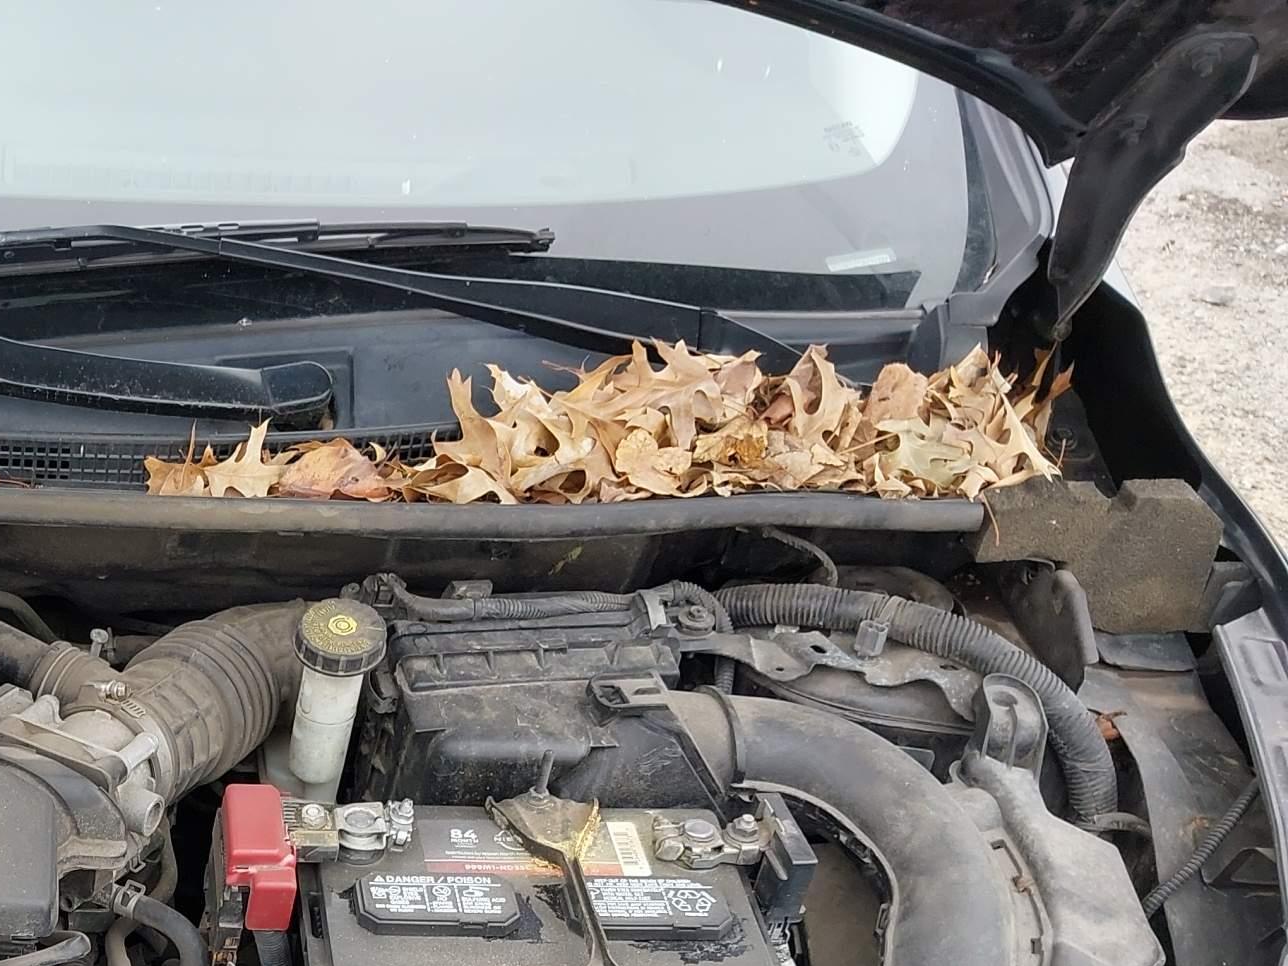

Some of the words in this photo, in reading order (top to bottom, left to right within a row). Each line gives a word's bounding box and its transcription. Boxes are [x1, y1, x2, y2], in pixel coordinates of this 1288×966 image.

[450, 828, 478, 840] 84
[385, 875, 435, 884] DANGER
[446, 876, 491, 885] POISON
